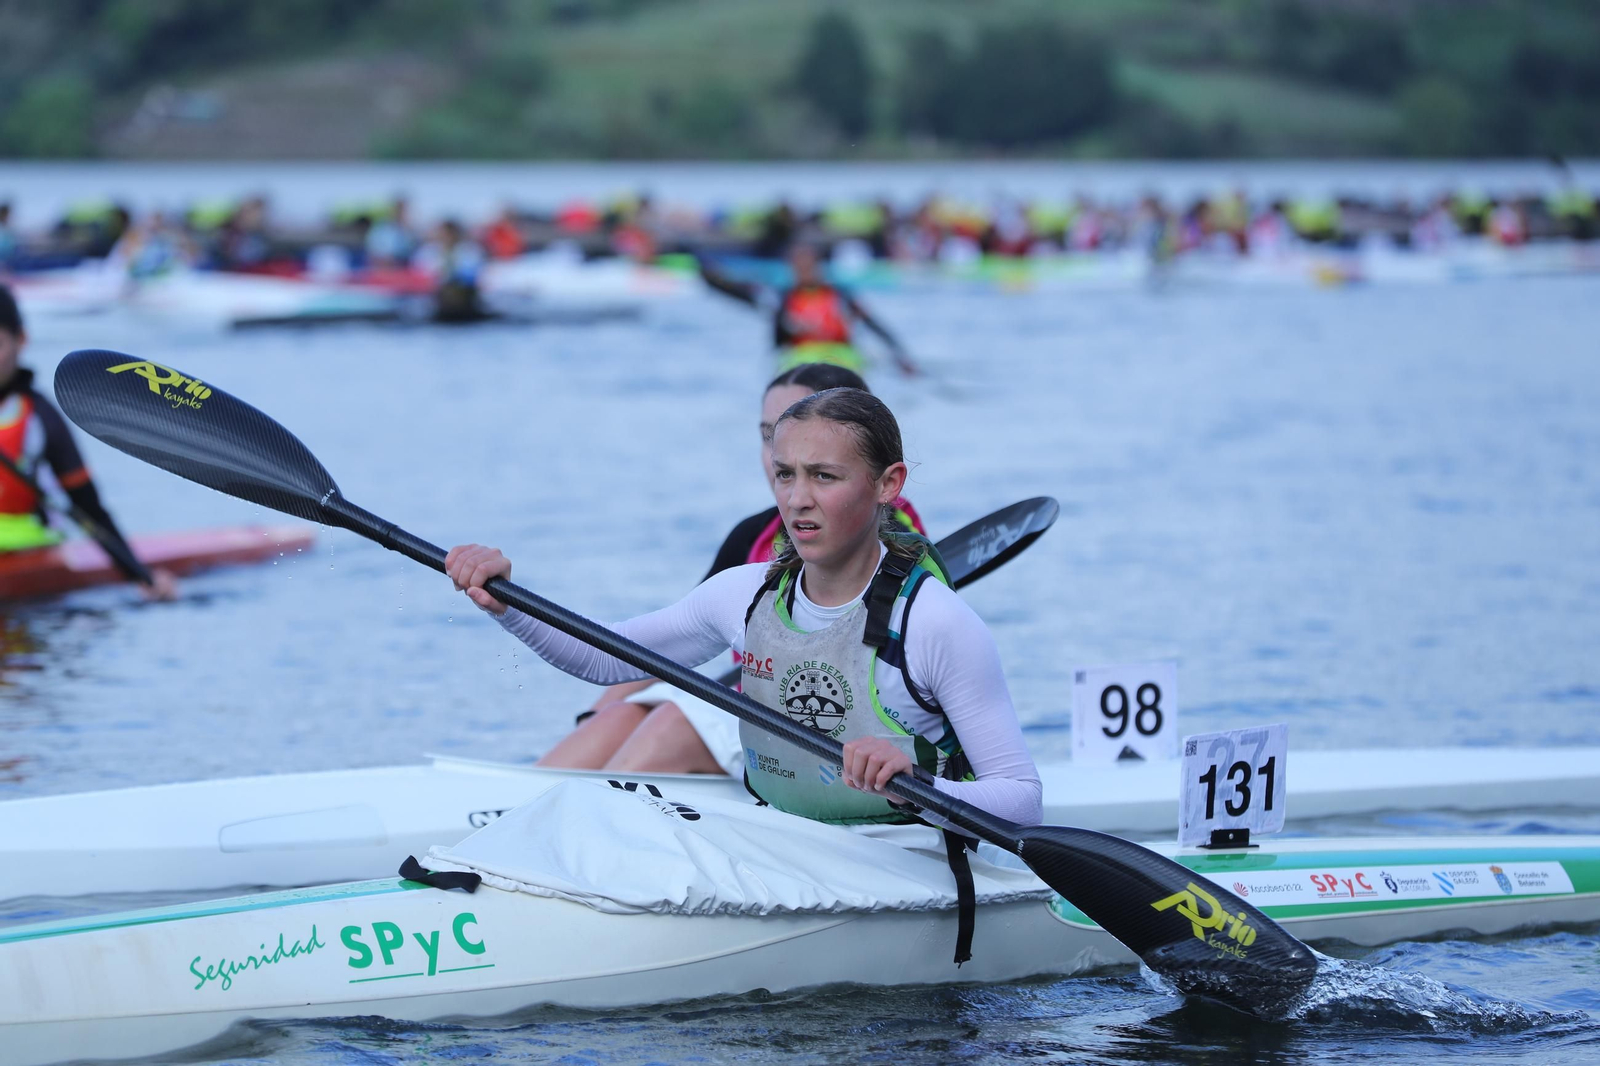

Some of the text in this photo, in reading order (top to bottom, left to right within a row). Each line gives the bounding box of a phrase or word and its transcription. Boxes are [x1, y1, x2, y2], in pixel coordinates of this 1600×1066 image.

[163, 387, 203, 409] kayaks
[742, 650, 773, 674] SPyC
[779, 677, 789, 706] CLUB
[786, 664, 802, 677] RÍA
[803, 660, 818, 669] DE
[820, 662, 854, 711] BETANZOS
[1099, 682, 1164, 739] 98
[757, 753, 780, 767] XUNTA
[758, 762, 796, 780] DE GALICIA
[1198, 755, 1276, 820] 131
[1309, 872, 1373, 898] SPyC
[189, 912, 487, 991] Seguridad SPyC
[1208, 933, 1248, 959] kayaks
